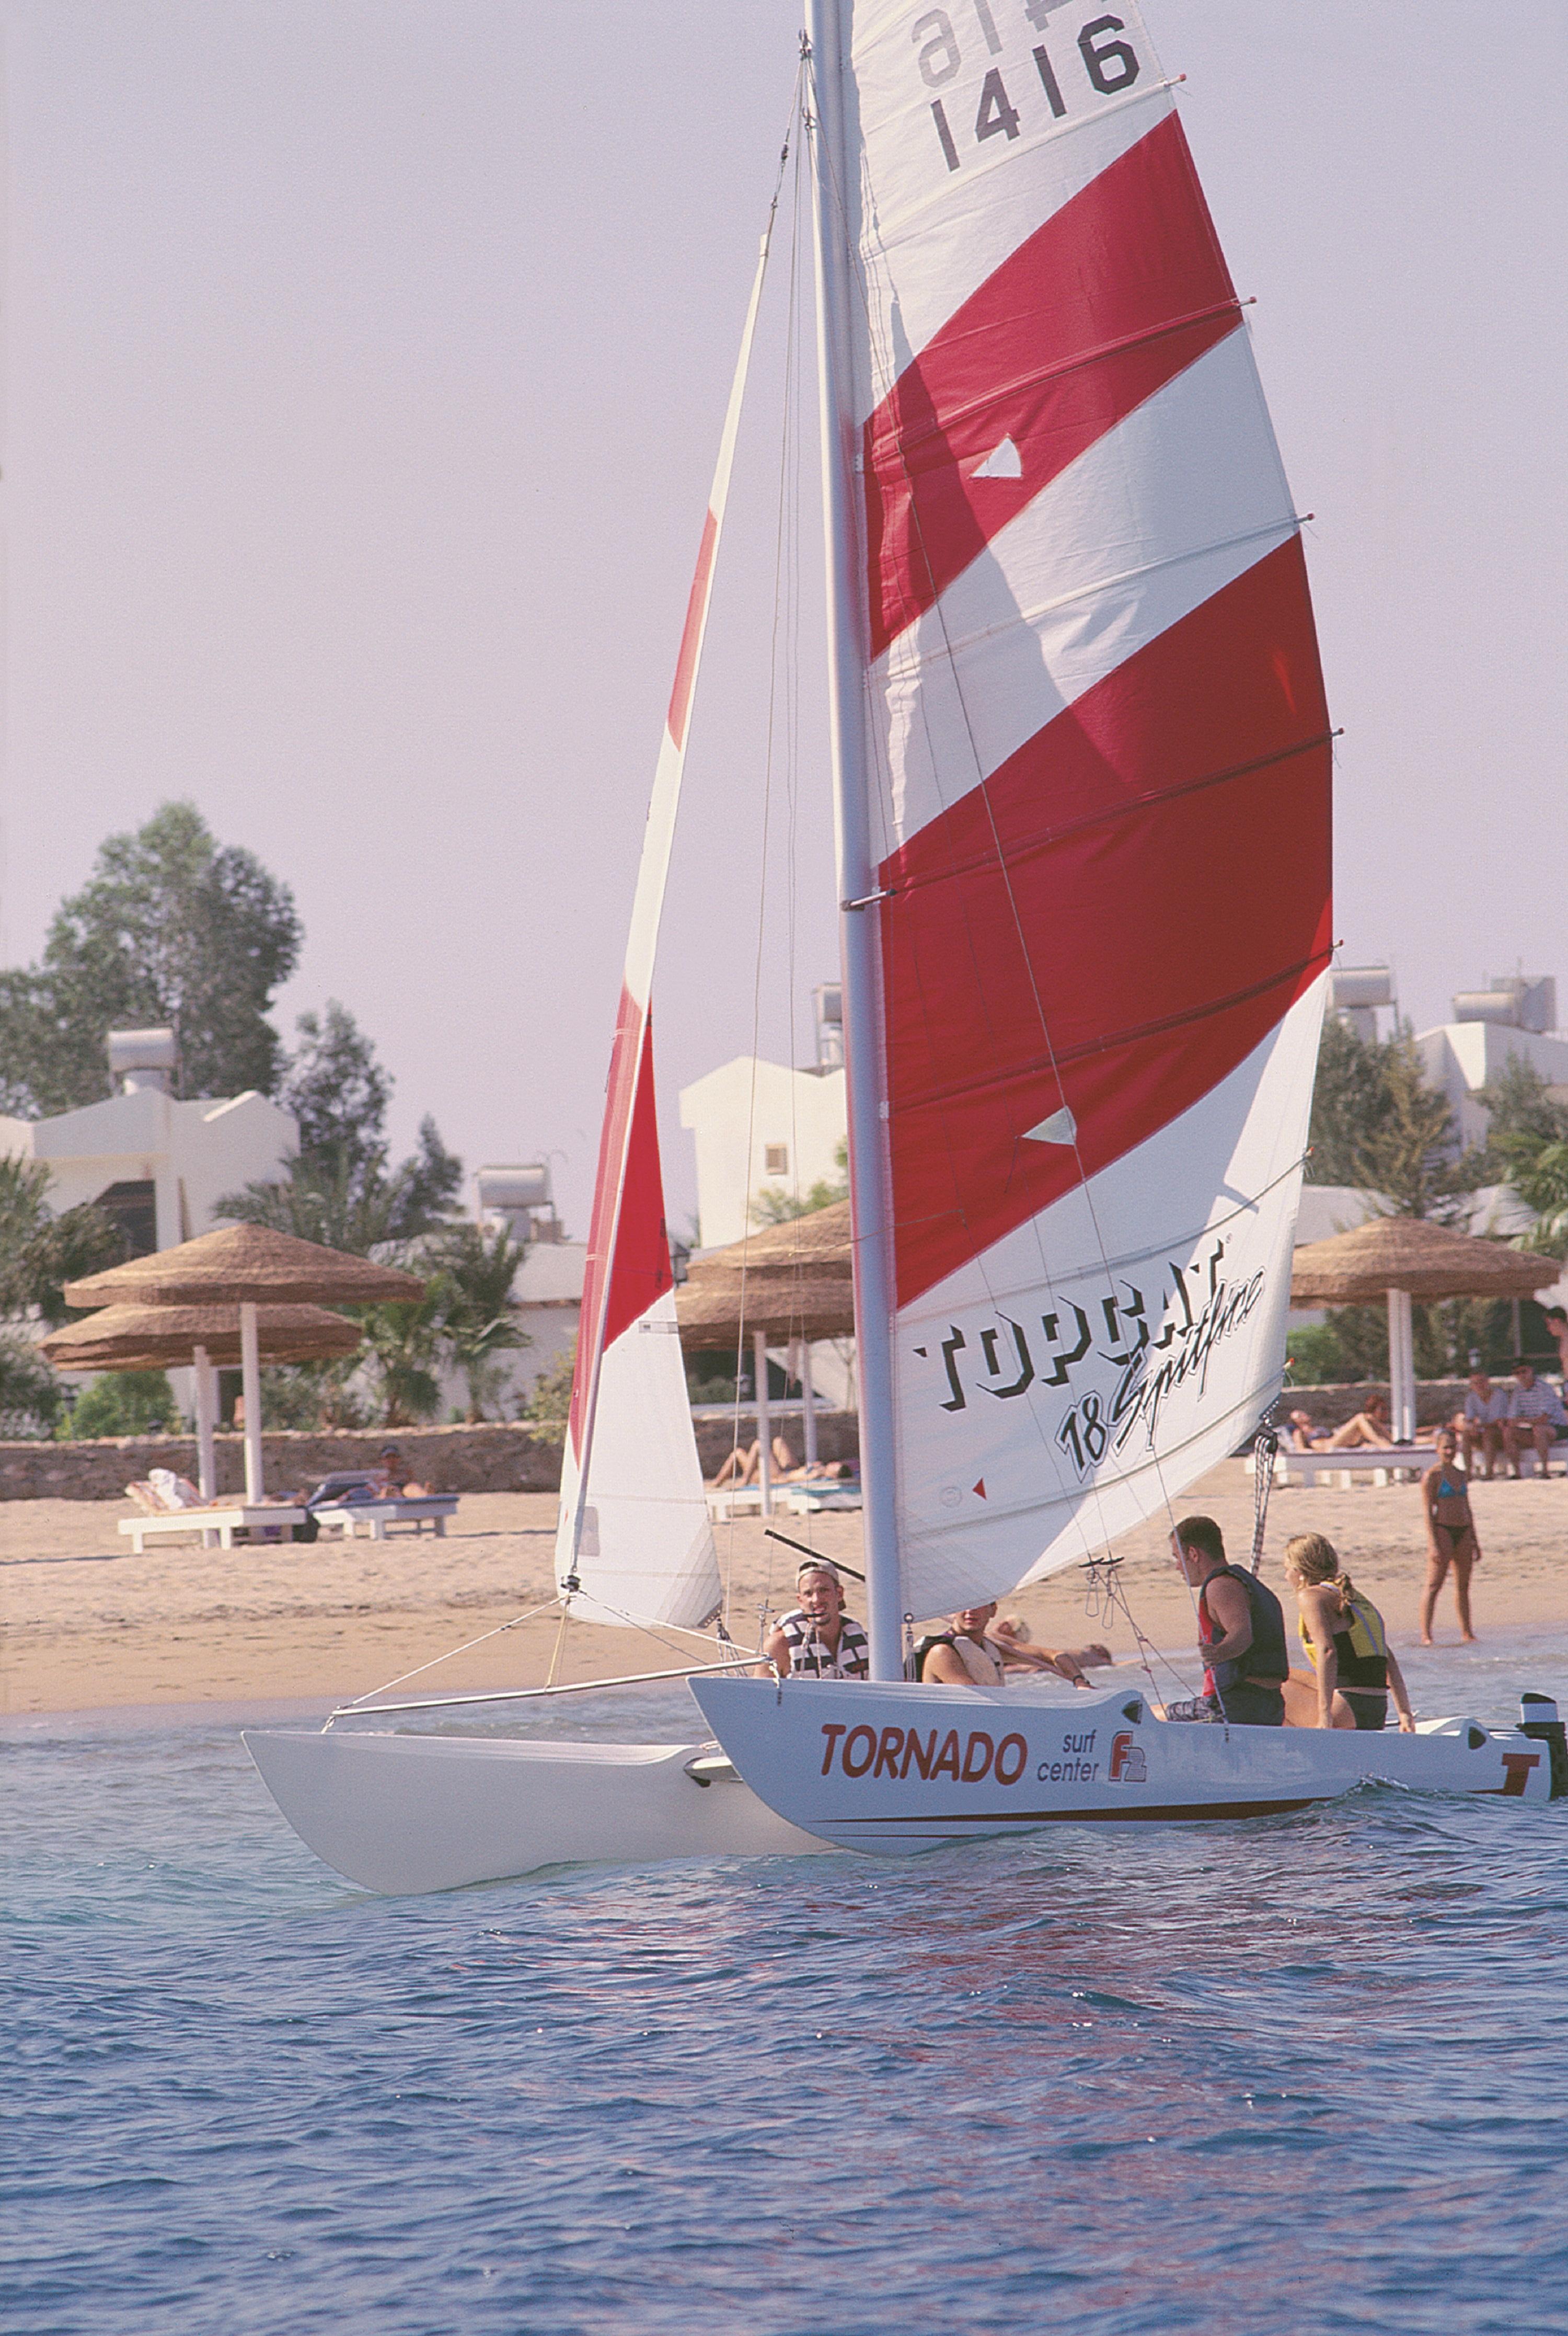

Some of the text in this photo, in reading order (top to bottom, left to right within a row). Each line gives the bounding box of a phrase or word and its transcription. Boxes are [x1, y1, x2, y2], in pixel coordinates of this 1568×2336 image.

[930, 14, 1140, 172] 1416
[1056, 1391, 1108, 1482] 18
[821, 1724, 1028, 1785] TORNADO
[1037, 1757, 1100, 1782] center
[1063, 1729, 1097, 1753] surf
